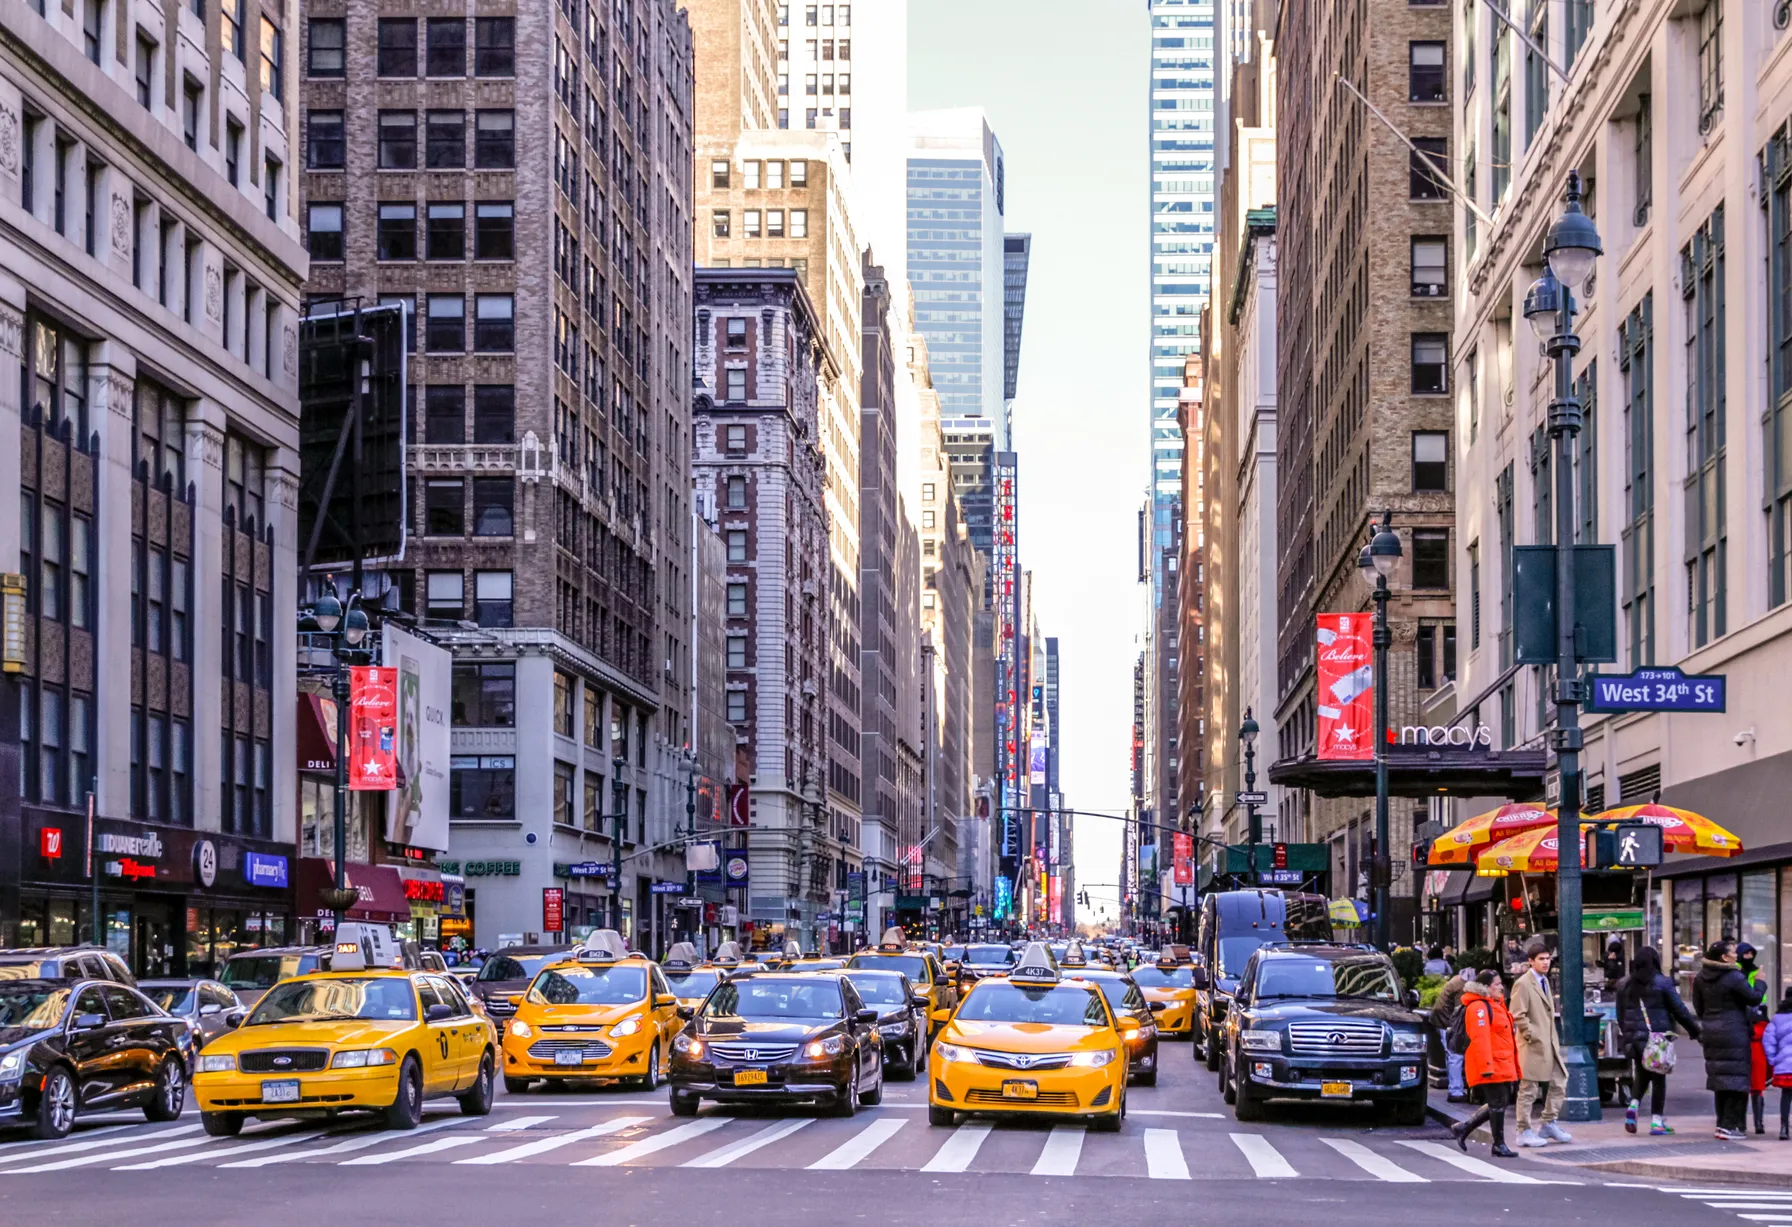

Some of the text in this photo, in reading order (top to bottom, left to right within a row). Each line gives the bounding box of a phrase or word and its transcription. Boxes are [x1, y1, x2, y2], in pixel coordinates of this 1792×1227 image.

[1320, 646, 1366, 661] Believe
[1602, 683, 1651, 702] West
[1655, 683, 1690, 703] 34th
[1695, 684, 1715, 703] St
[352, 694, 392, 707] Believe
[1401, 720, 1492, 752] macy's
[308, 760, 330, 768] DELI
[203, 848, 213, 869] 24
[465, 861, 521, 877] COFFEE
[572, 866, 588, 874] West
[600, 866, 607, 874] St
[1292, 873, 1300, 881] St
[317, 908, 334, 917] DEL
[337, 943, 357, 953] 2A31
[1025, 967, 1044, 976] 4K37
